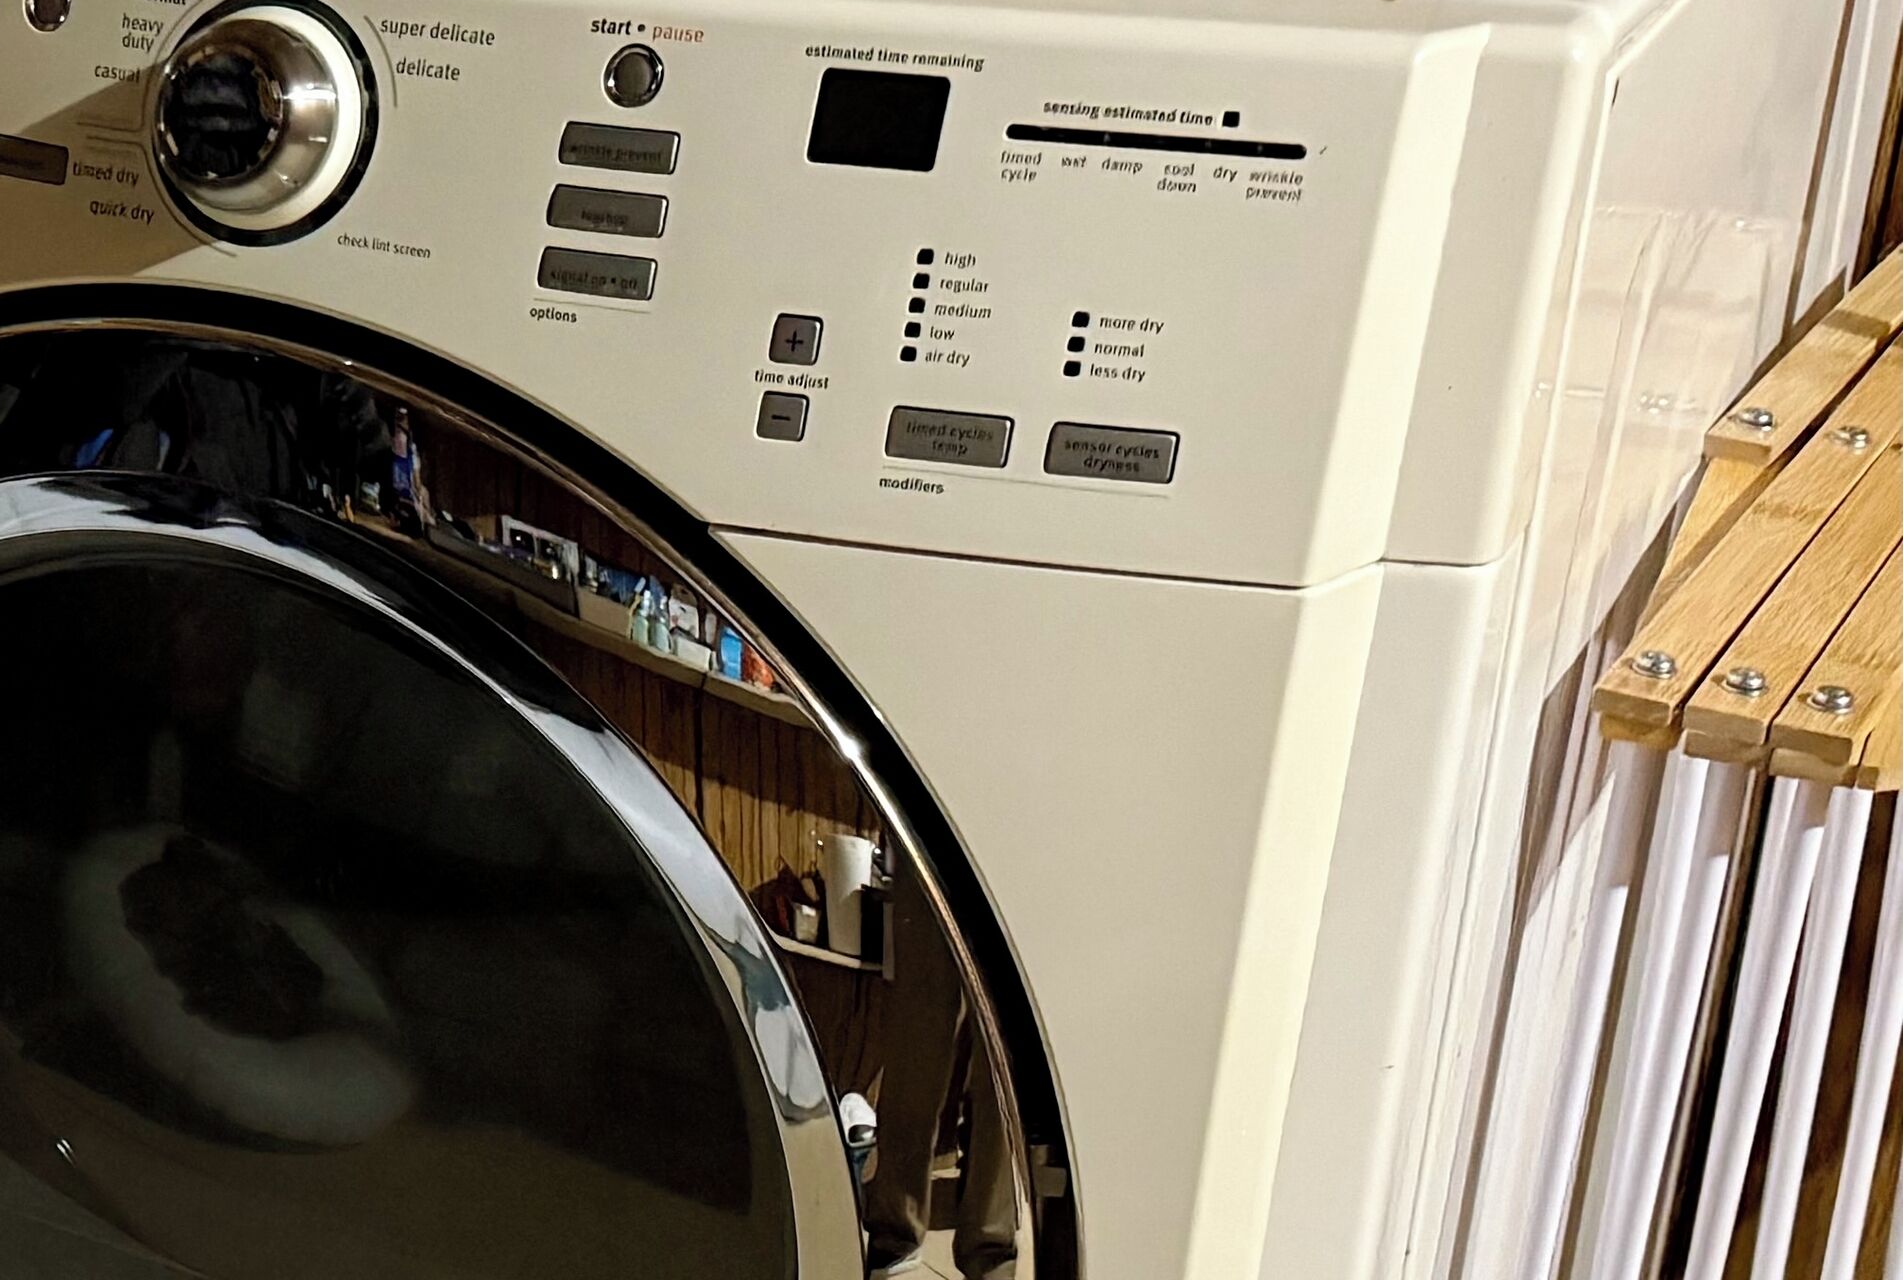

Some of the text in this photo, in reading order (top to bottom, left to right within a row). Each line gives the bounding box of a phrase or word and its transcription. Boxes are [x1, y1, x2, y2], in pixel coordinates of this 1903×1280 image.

[121, 11, 164, 37] heavy
[379, 18, 496, 47] super delicate
[590, 17, 705, 43] start pause
[121, 31, 155, 54] duty
[396, 55, 461, 82] delicate
[804, 44, 986, 73] estimated time remaining
[94, 64, 141, 84] casual
[1042, 100, 1214, 126] sensing estimated time
[72, 161, 140, 188] timed dry
[999, 149, 1043, 167] timed
[1100, 155, 1144, 174] damp
[1212, 165, 1238, 183] dry
[1248, 169, 1305, 187] wrinkle
[1000, 167, 1038, 184] cycle
[1155, 177, 1198, 194] down
[89, 199, 155, 226] quick dry
[337, 231, 431, 259] check lint screen
[944, 250, 977, 269] high
[550, 267, 589, 284] signal
[939, 276, 990, 294] regular
[528, 306, 578, 323] options
[933, 302, 992, 320] medium
[929, 324, 956, 341] low
[1098, 315, 1165, 335] more dry
[924, 348, 972, 369] air dry
[1093, 341, 1146, 359] normal
[753, 369, 830, 391] time adjust
[1089, 362, 1147, 384] less dry
[906, 420, 995, 443] timed cycles
[930, 439, 969, 458] temp
[1063, 438, 1161, 462] sensor cycles
[1081, 454, 1141, 474] dryness
[878, 476, 946, 495] modifiers
